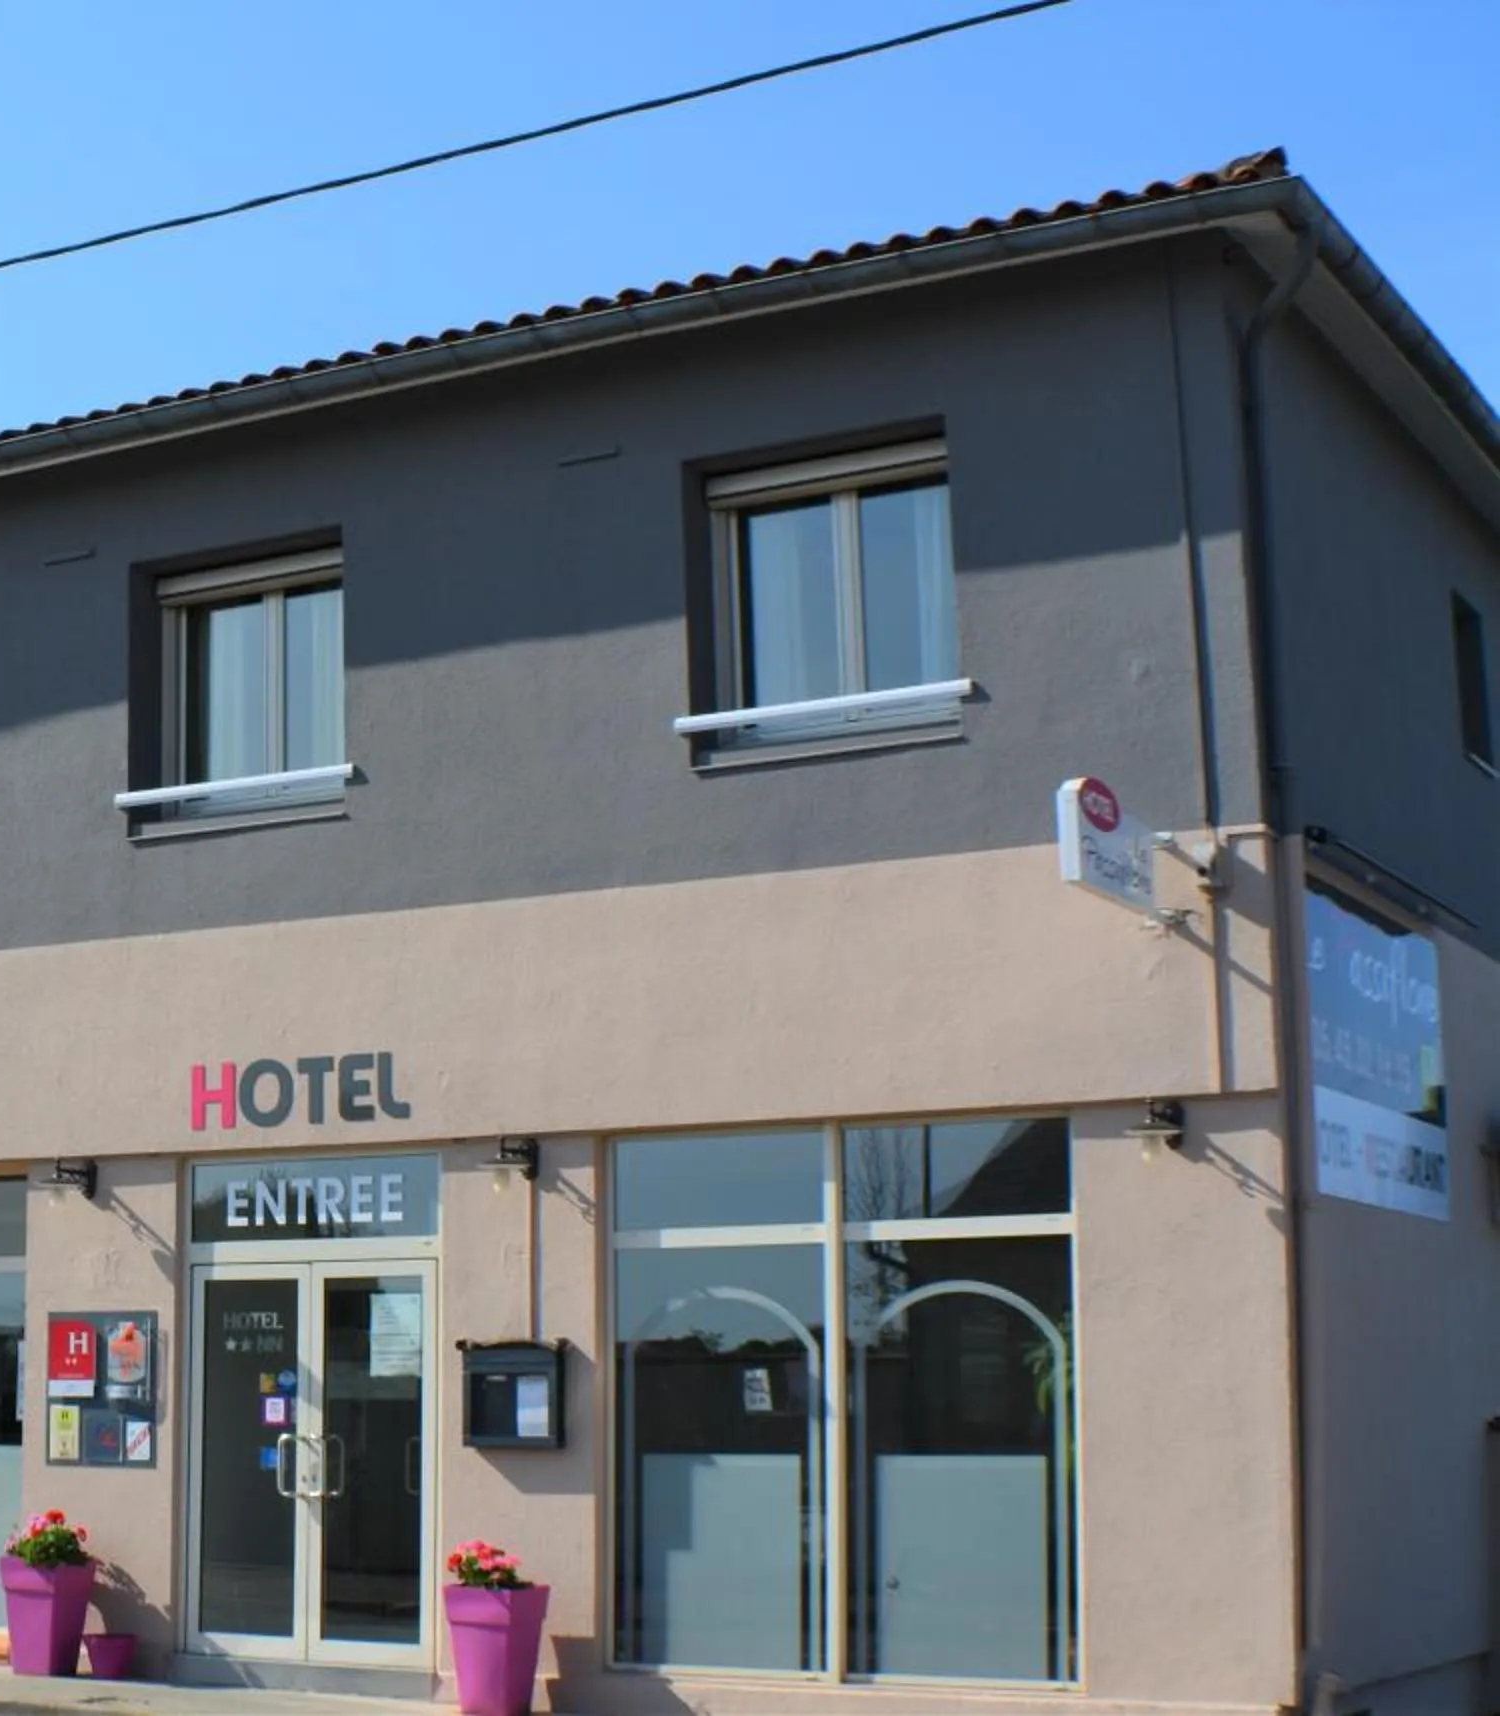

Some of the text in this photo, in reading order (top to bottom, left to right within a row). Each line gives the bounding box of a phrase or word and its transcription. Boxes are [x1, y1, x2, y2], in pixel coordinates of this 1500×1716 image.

[190, 1051, 411, 1132] HOTEL
[226, 1174, 403, 1227] ENTREE
[223, 1311, 284, 1329] HOTEL
[68, 1331, 89, 1355] H
